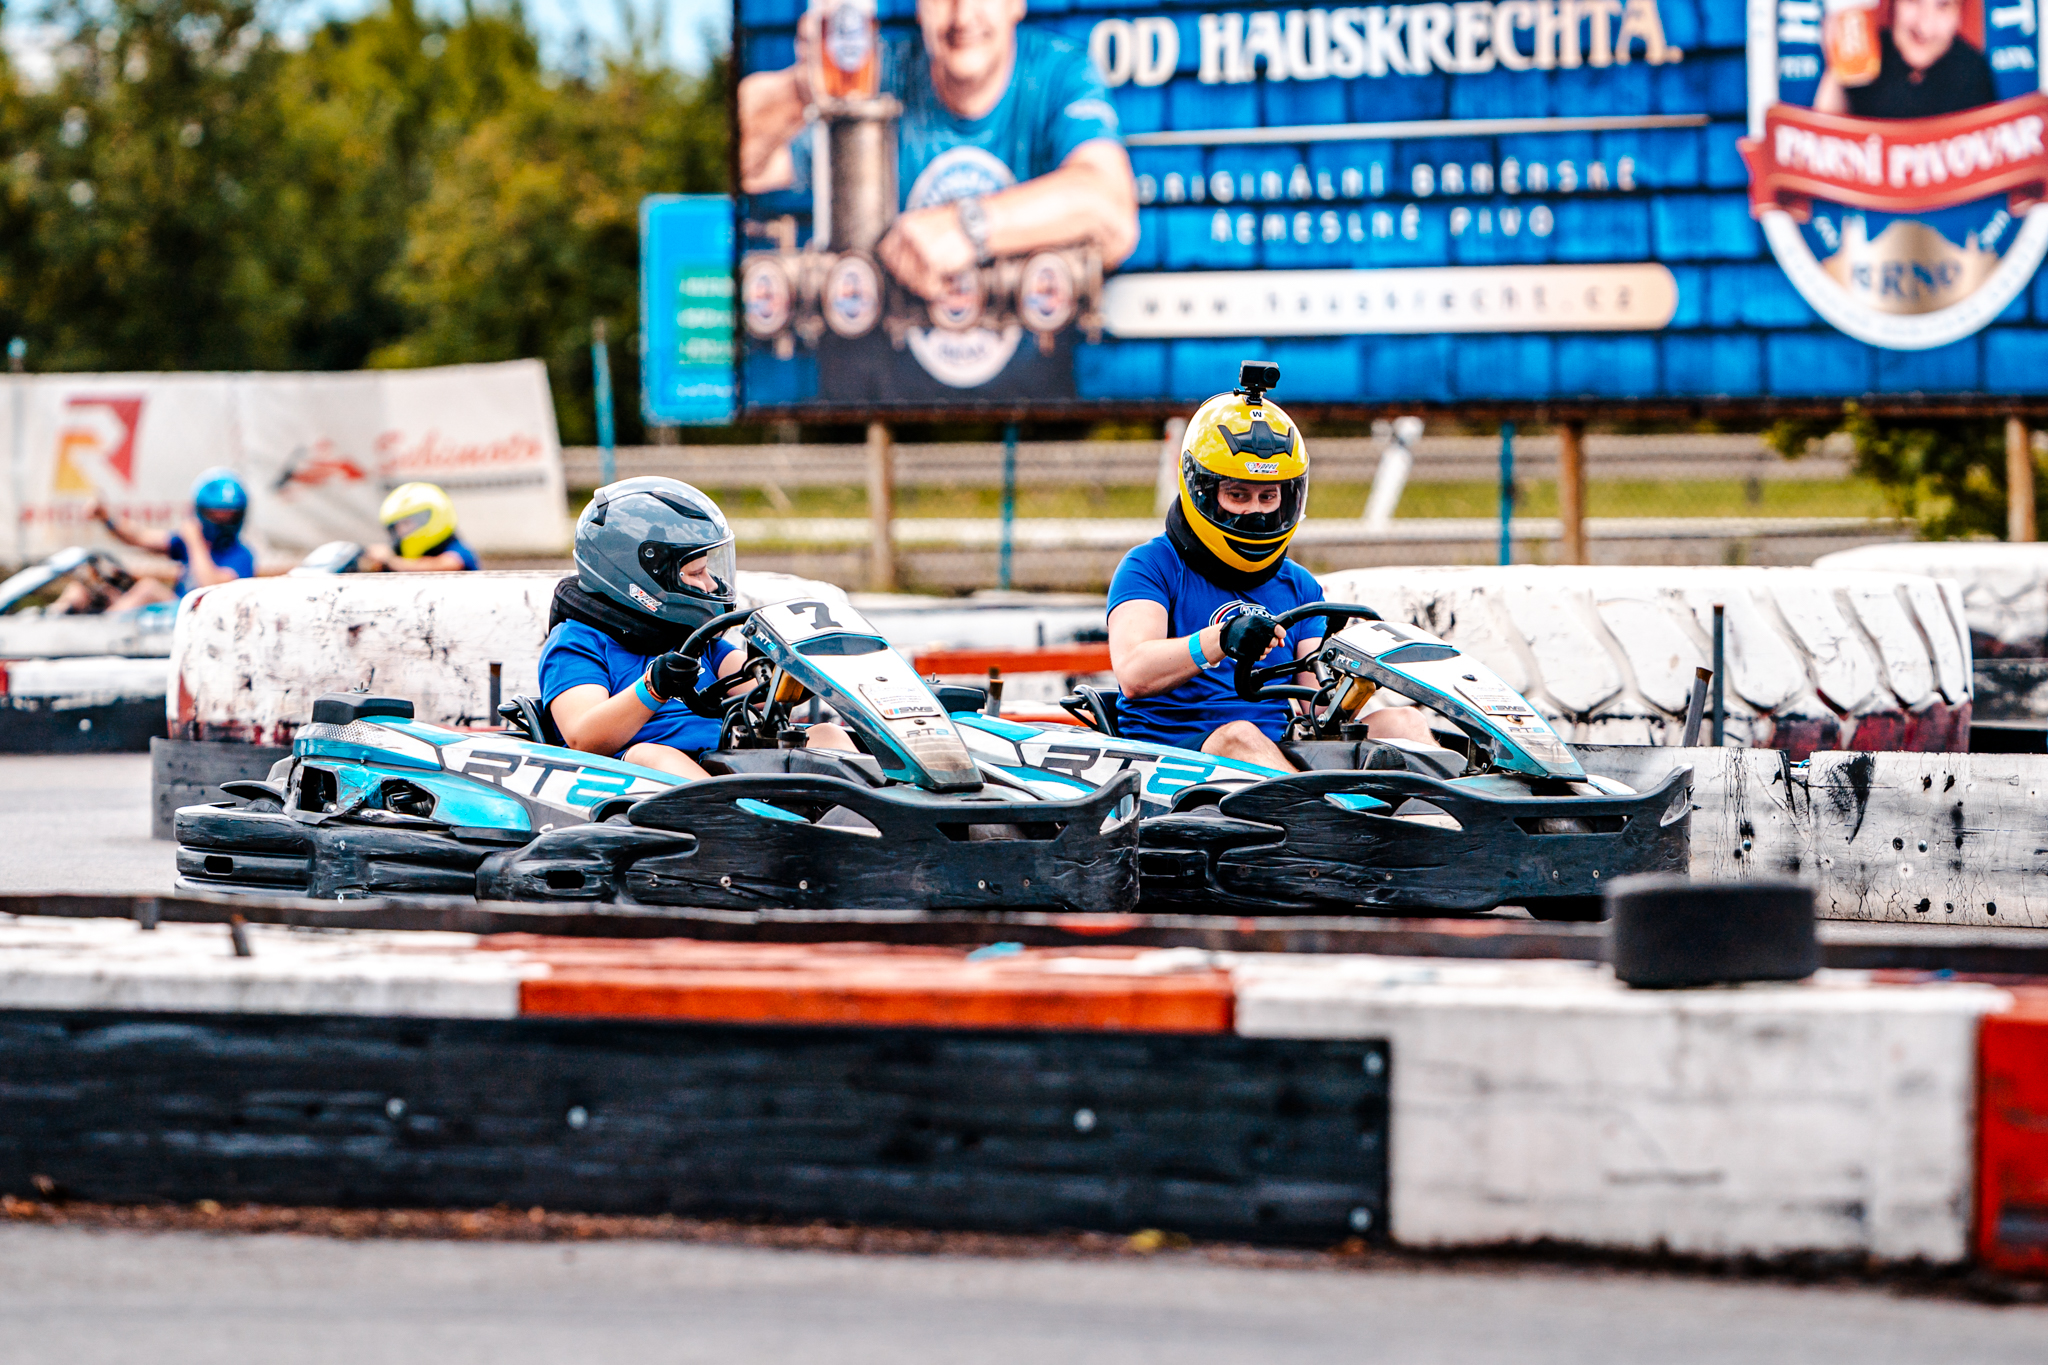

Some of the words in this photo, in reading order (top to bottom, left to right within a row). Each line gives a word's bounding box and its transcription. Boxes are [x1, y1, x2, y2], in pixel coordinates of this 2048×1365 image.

[1089, 17, 1179, 87] OD
[1198, 0, 1684, 84] HAUSKRECHTA.
[1449, 205, 1555, 238] PIVO
[786, 602, 843, 630] 7
[1370, 622, 1414, 643] 1
